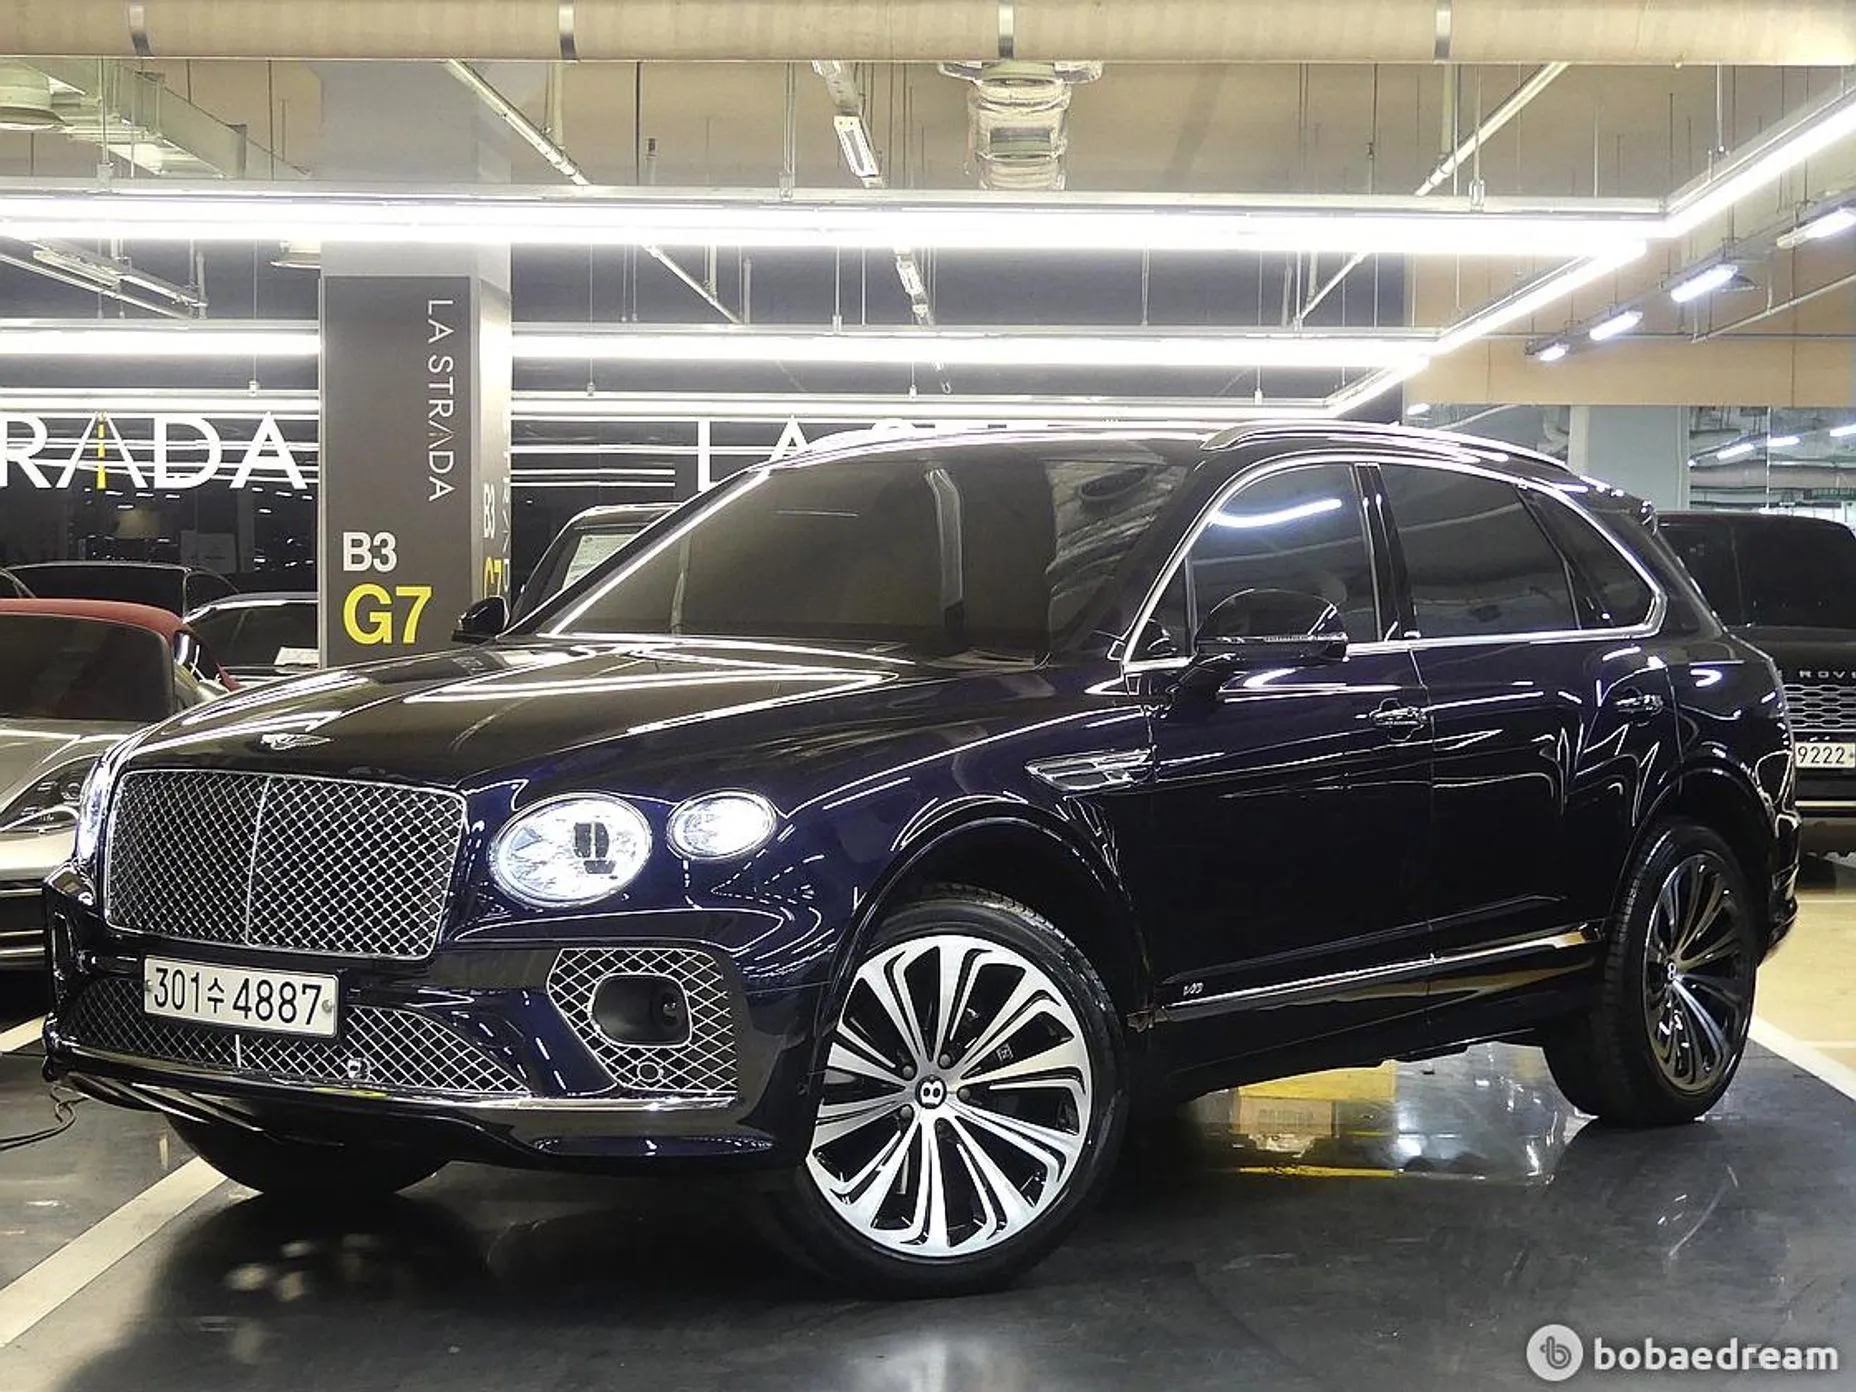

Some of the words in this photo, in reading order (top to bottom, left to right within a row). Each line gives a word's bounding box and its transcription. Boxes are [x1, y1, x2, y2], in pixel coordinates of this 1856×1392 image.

[428, 300, 455, 343] LA
[428, 355, 456, 501] STRADA
[343, 531, 398, 572] B3
[343, 583, 433, 645] G7
[1797, 745, 1846, 764] 9222
